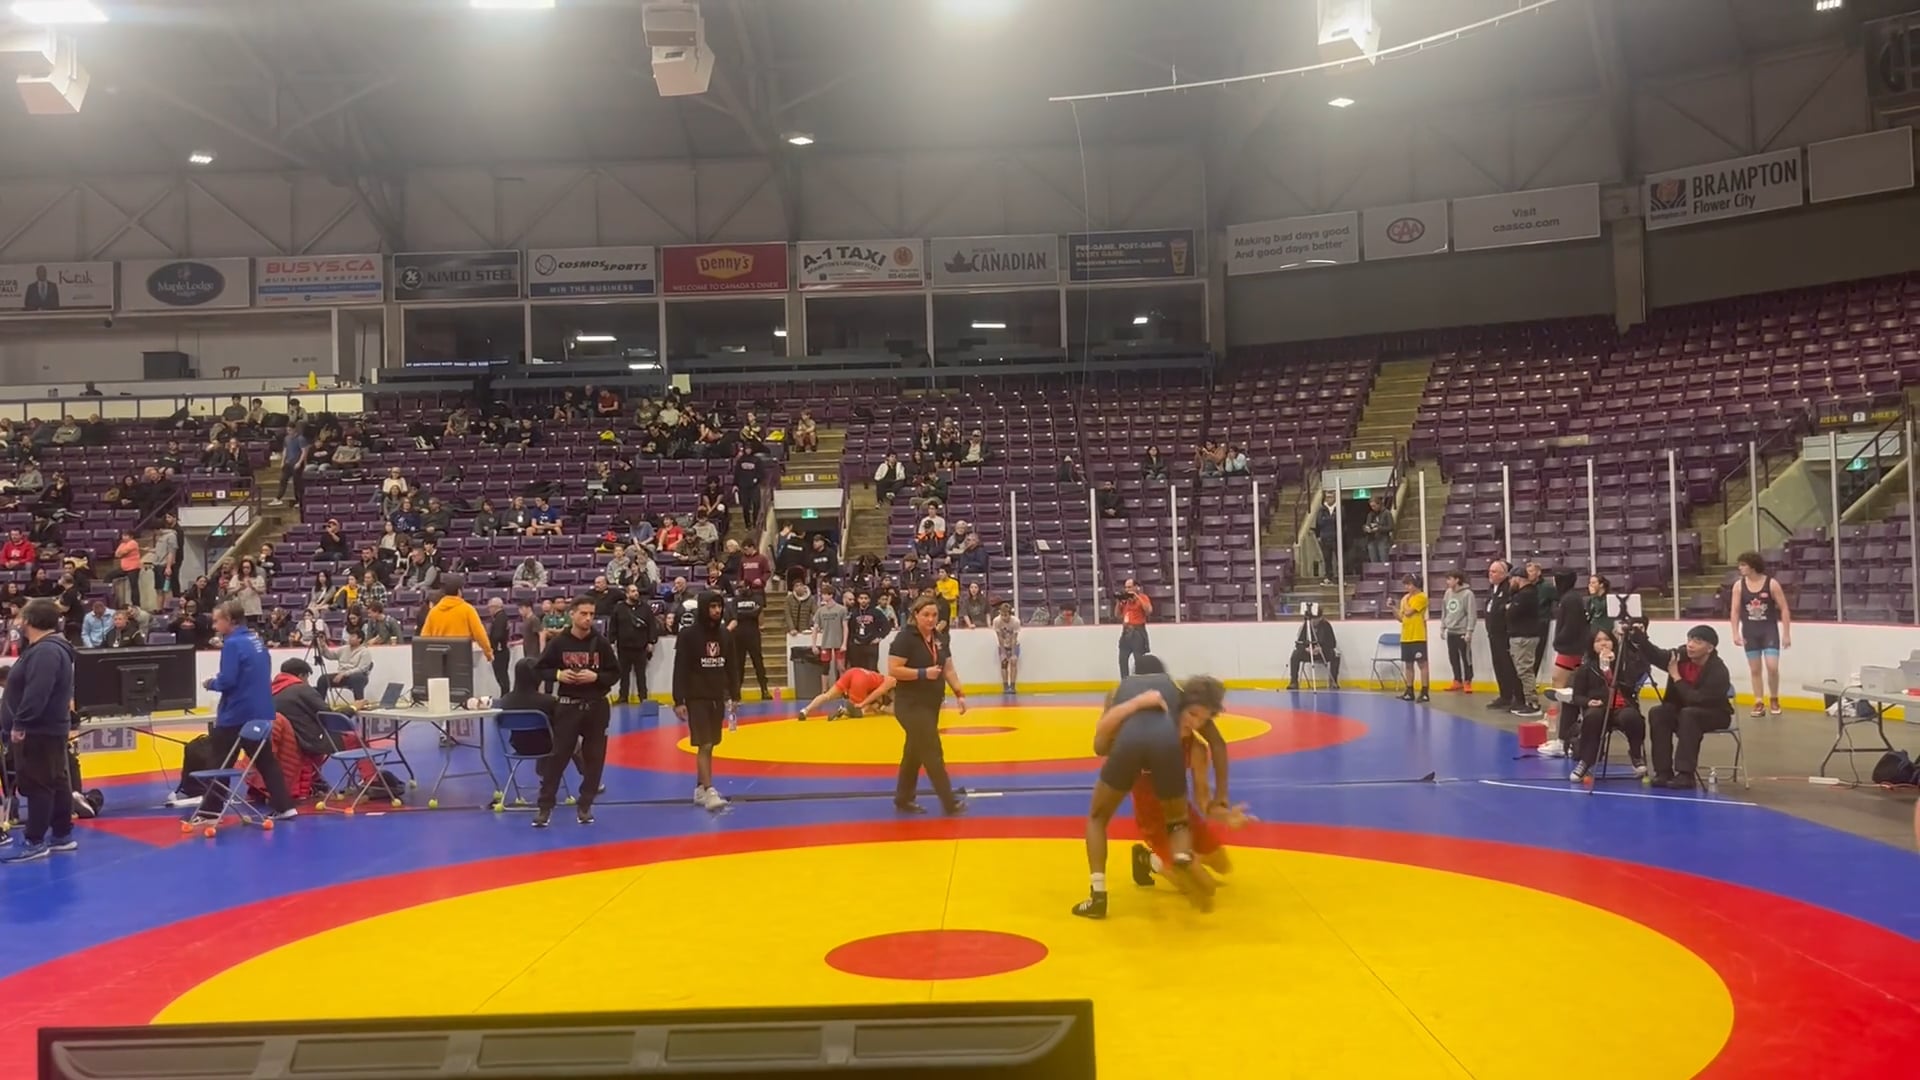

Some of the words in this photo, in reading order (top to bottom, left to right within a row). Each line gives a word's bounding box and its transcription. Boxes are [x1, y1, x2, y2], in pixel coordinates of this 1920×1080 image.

[1693, 158, 1797, 198] BRAMPTON
[1693, 199, 1731, 215] Flower
[1734, 193, 1756, 209] City
[1512, 207, 1537, 218] Visit
[1391, 221, 1421, 242] CAA
[1492, 217, 1560, 233] caasco.com
[1234, 235, 1272, 247] Making
[1273, 232, 1293, 243] bad
[1295, 231, 1319, 242] days
[1322, 226, 1350, 239] good
[803, 247, 833, 269] A-1
[836, 246, 887, 267] TAXI
[1235, 249, 1255, 259] And
[1256, 246, 1283, 259] good
[1285, 244, 1310, 255] days
[265, 259, 376, 274] BUSYS.CA
[700, 255, 750, 272] Denny's
[971, 251, 1047, 272] CANADIAN
[475, 269, 513, 281] STEEL
[157, 281, 186, 293] Maple
[187, 279, 214, 292] Lodge
[570, 285, 586, 293] THE
[589, 284, 634, 292] BUSINESS
[672, 283, 709, 291] WELCOME
[720, 282, 756, 290] CANADA'S
[757, 281, 779, 289] DINER
